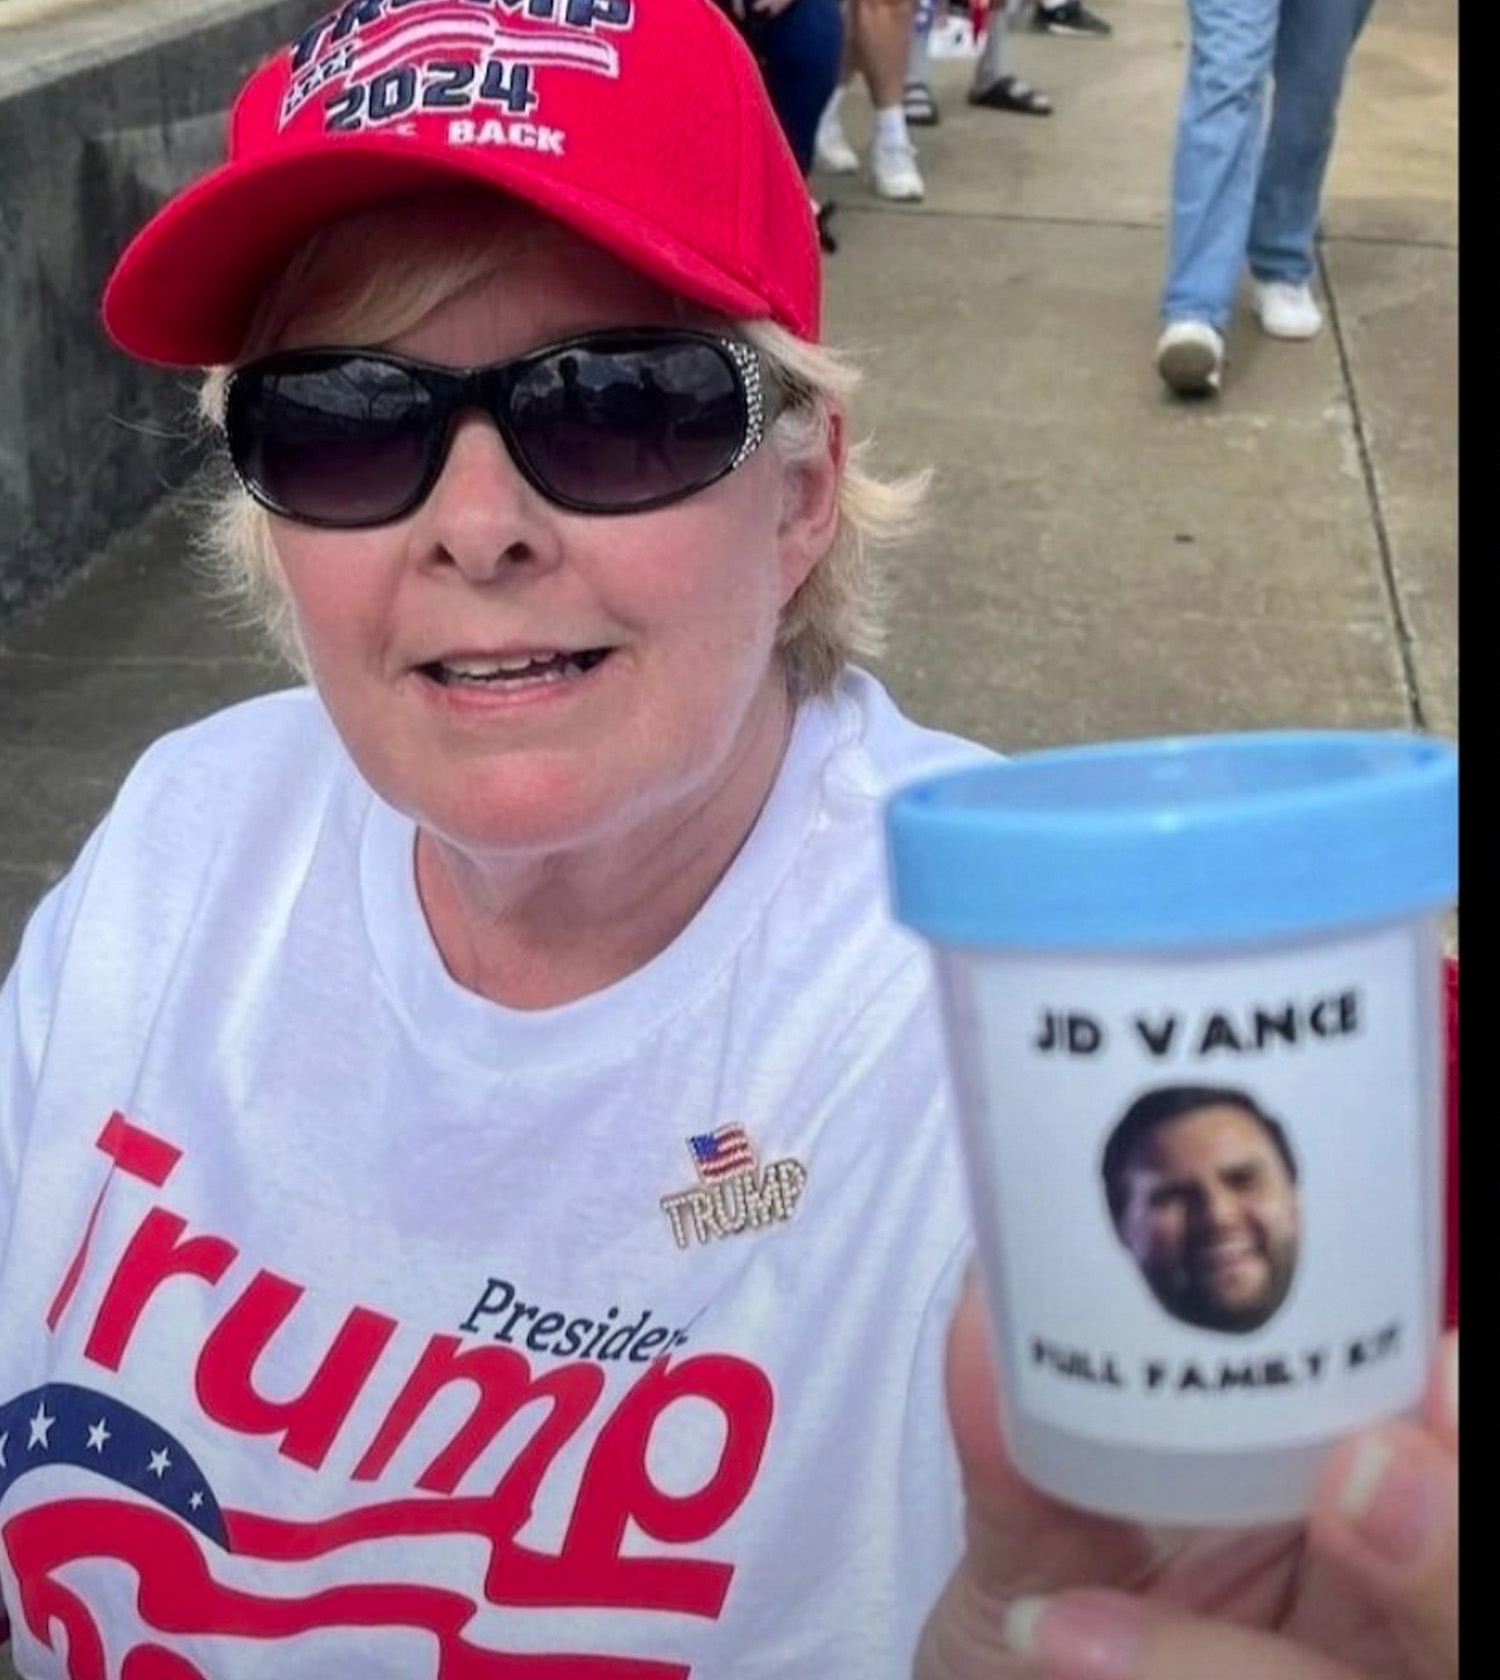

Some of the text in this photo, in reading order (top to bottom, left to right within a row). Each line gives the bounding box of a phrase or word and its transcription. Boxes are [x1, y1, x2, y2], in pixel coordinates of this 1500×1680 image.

[324, 60, 539, 131] 2024
[449, 120, 566, 154] BACK
[1037, 990, 1360, 1057] JD VANCE
[659, 1158, 808, 1250] TRUMP
[47, 1111, 776, 1575] Trump
